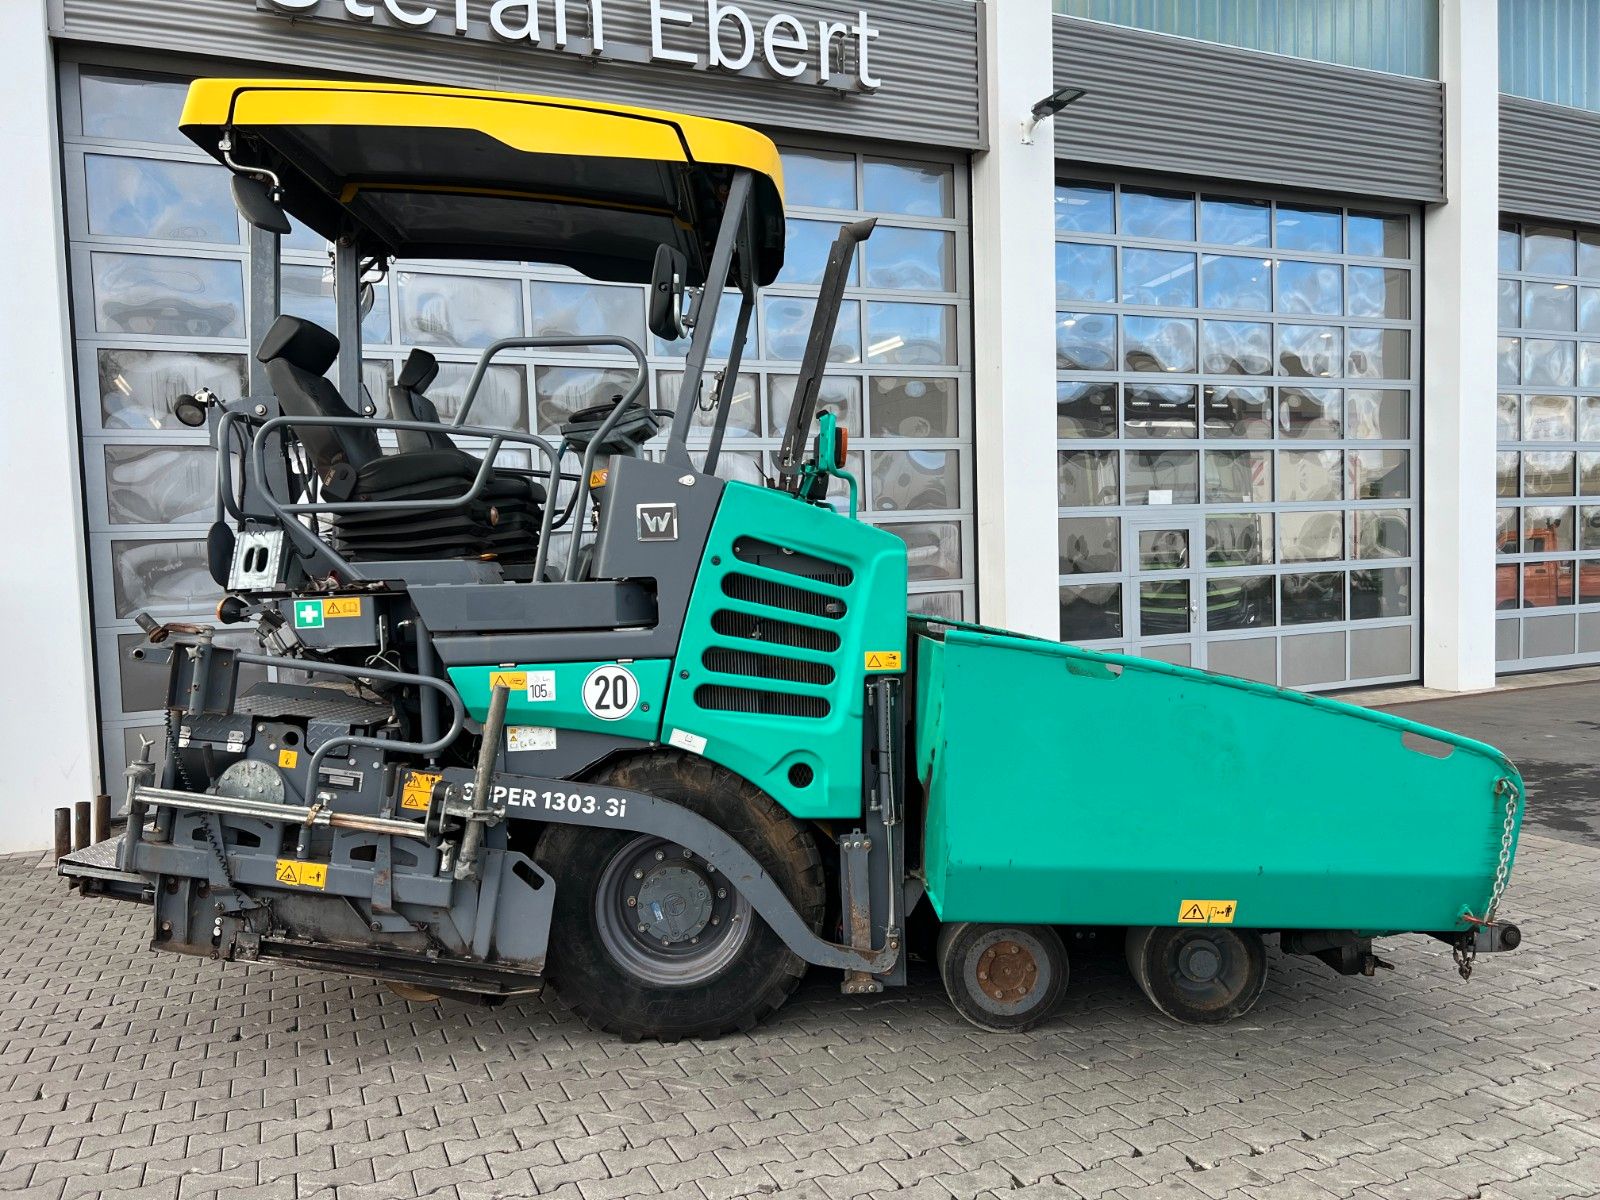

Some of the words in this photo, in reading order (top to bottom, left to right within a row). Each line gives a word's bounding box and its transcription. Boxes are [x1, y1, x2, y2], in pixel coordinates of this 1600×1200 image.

[650, 0, 881, 88] Ebert
[642, 512, 672, 533] W
[530, 684, 548, 698] 105
[594, 675, 628, 710] 20
[462, 782, 537, 808] SPER
